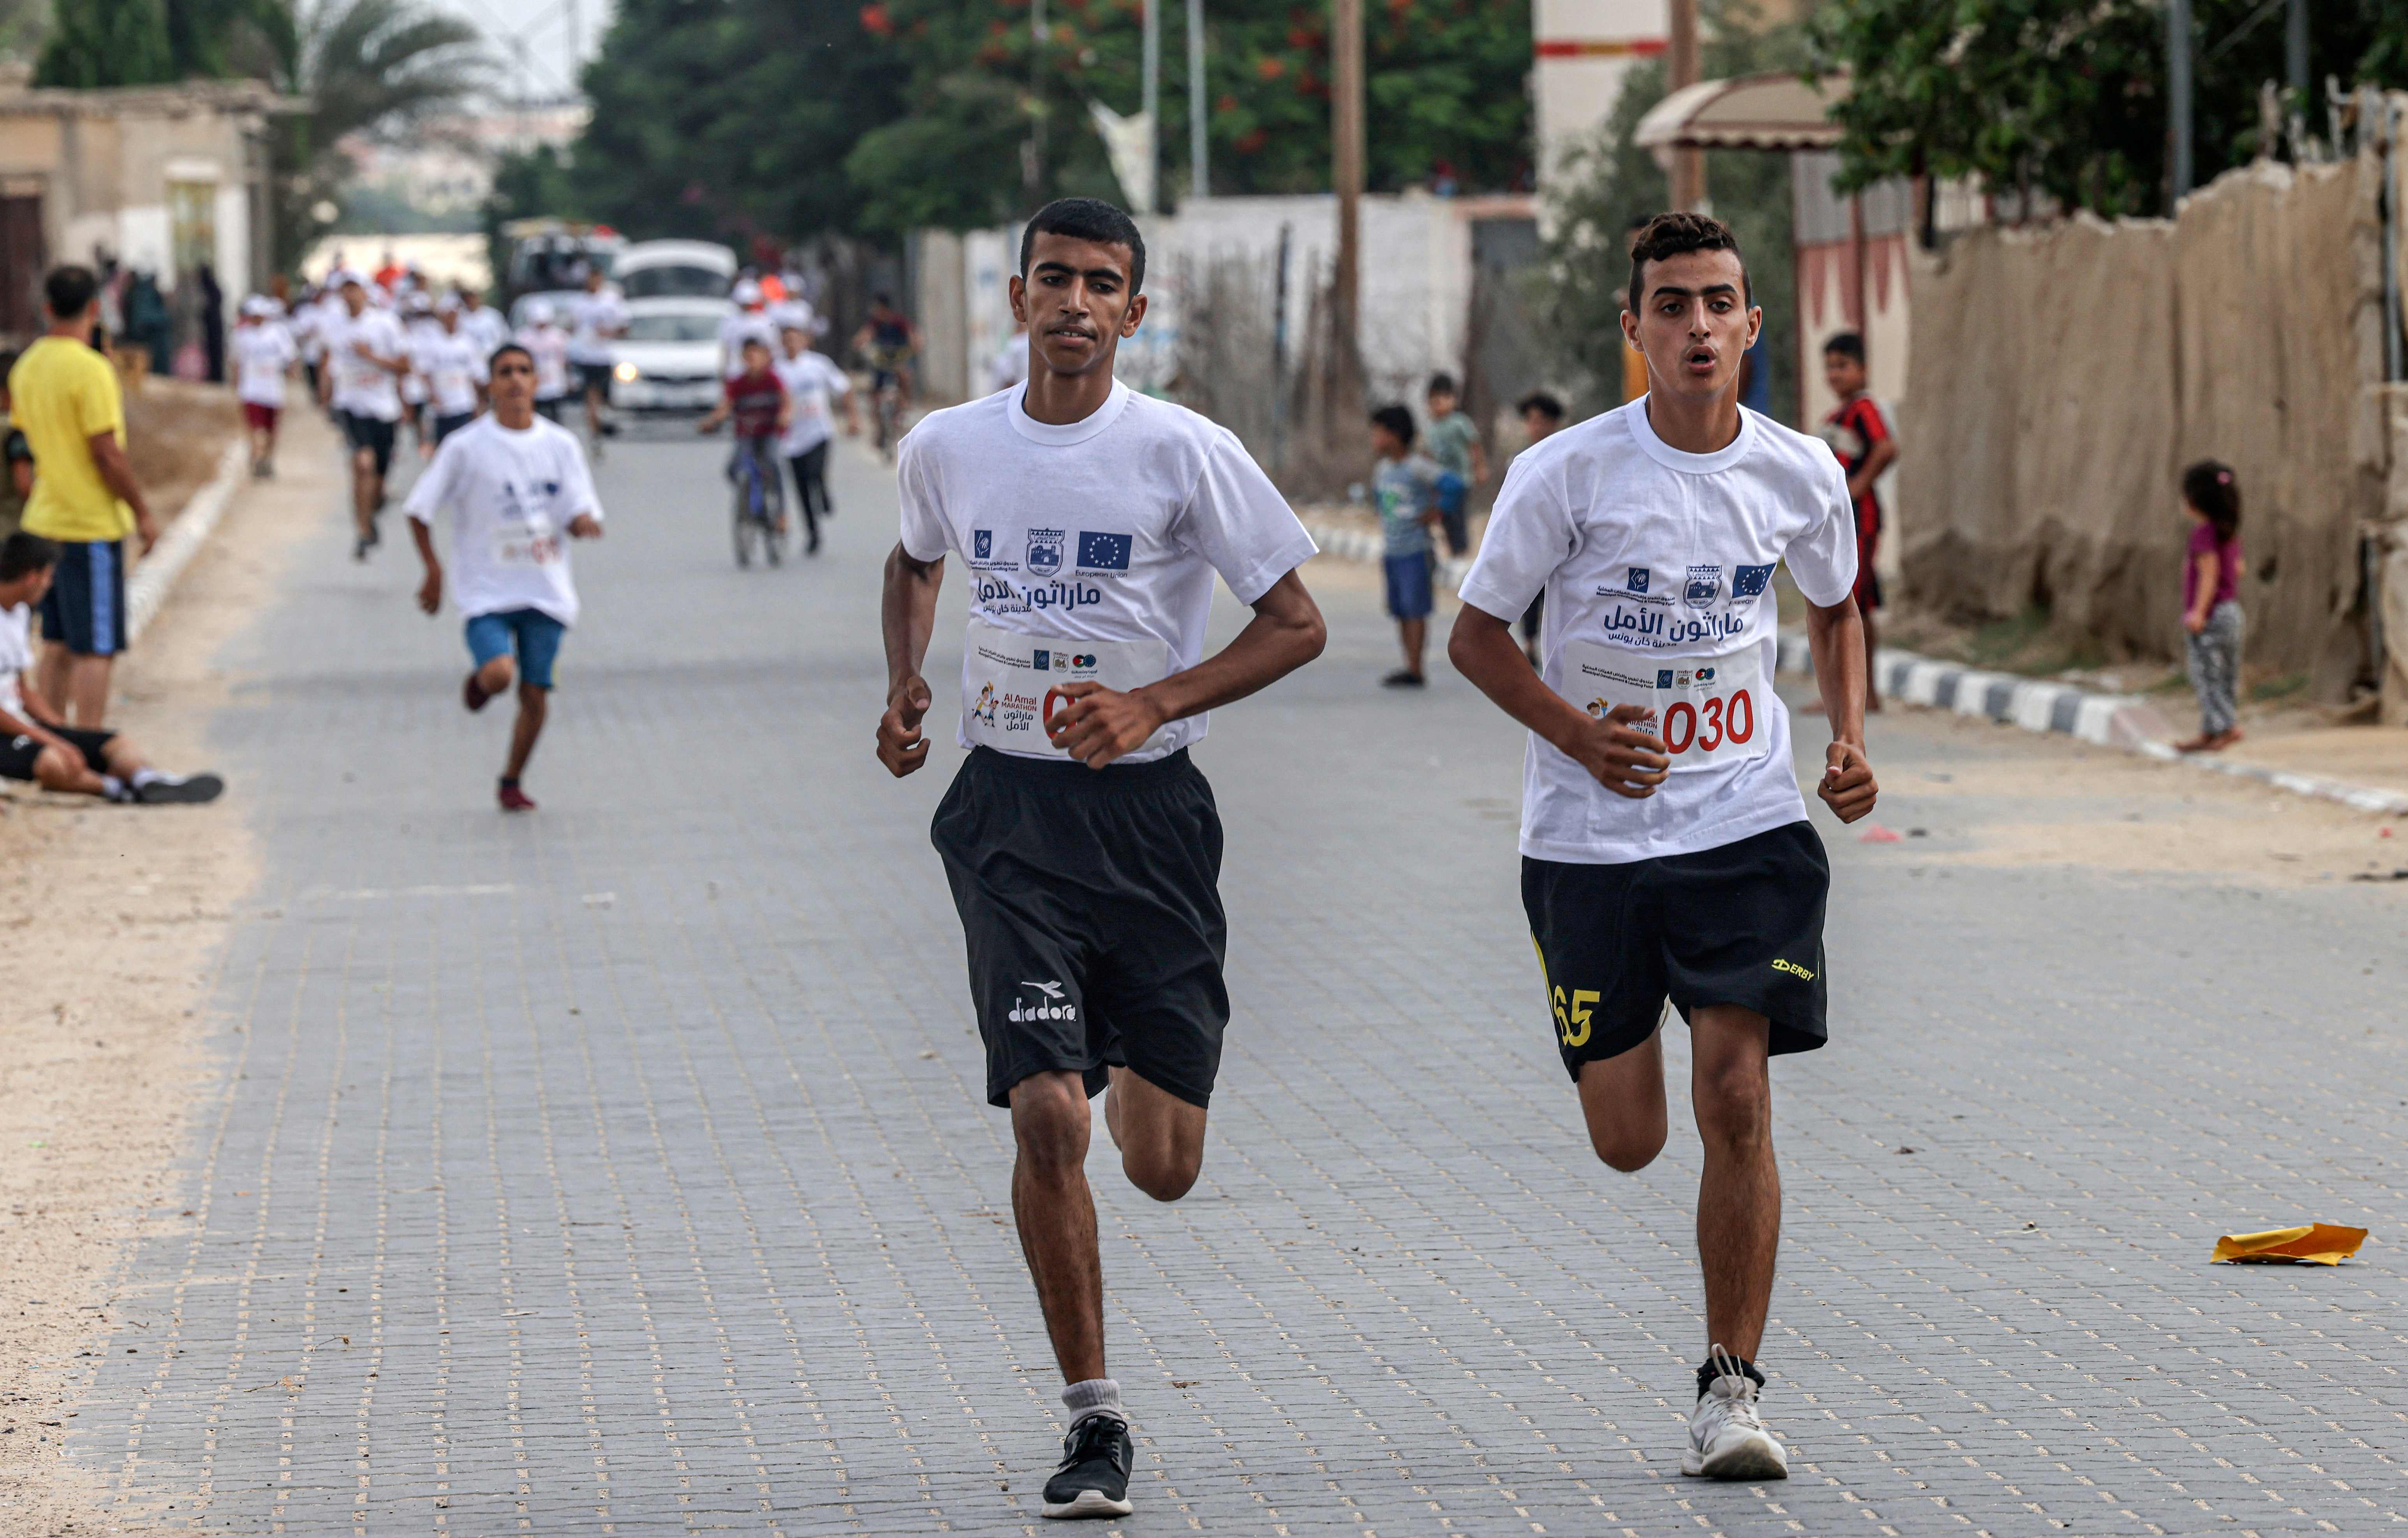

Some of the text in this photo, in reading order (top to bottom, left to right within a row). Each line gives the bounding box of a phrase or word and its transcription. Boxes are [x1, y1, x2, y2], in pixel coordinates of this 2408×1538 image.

[1075, 570, 1108, 578] European
[997, 604, 1009, 615] خان
[1011, 604, 1031, 614] مدينة
[1604, 605, 1743, 642] ماراثون الأمل
[1608, 633, 1633, 645] يونس
[1635, 637, 1651, 646] خان
[1600, 673, 1624, 683] Development
[1004, 693, 1037, 706] Al Amal
[1001, 702, 1037, 712] MARATHON
[1004, 709, 1033, 721] ماراثون
[1006, 720, 1029, 731] الأمل
[1663, 689, 1754, 754] 030
[1771, 958, 1815, 982] DERBY
[1008, 996, 1076, 1022] diadora
[1554, 984, 1600, 1047] 65
